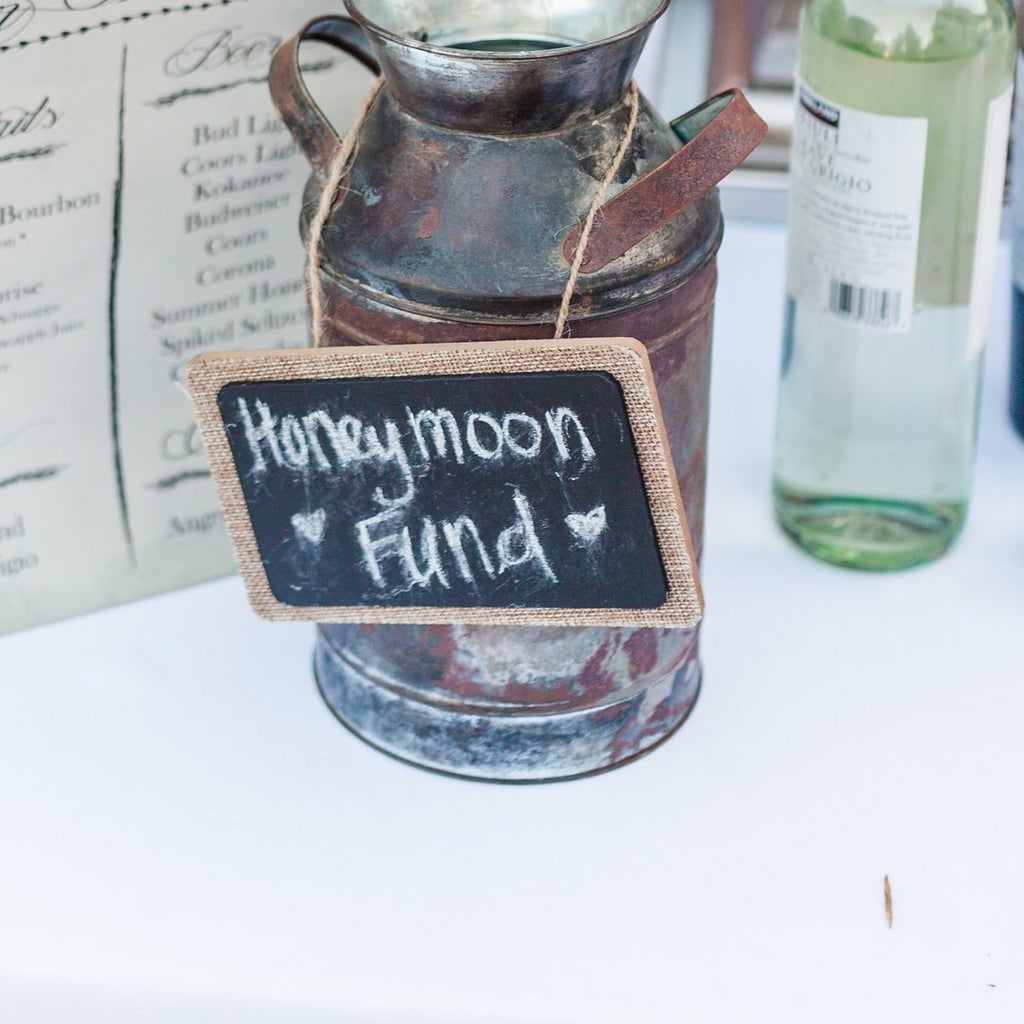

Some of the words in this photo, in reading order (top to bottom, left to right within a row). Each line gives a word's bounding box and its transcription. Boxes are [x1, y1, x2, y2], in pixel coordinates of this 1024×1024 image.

[193, 118, 240, 146] Bud
[182, 154, 246, 176] Coors
[185, 192, 292, 233] Budweiser
[205, 229, 269, 255] Coors
[196, 257, 275, 286] Corona
[152, 294, 241, 324] Summer
[162, 321, 235, 357] Spiked
[237, 395, 595, 507] Honeymoon
[356, 483, 558, 591] Fund
